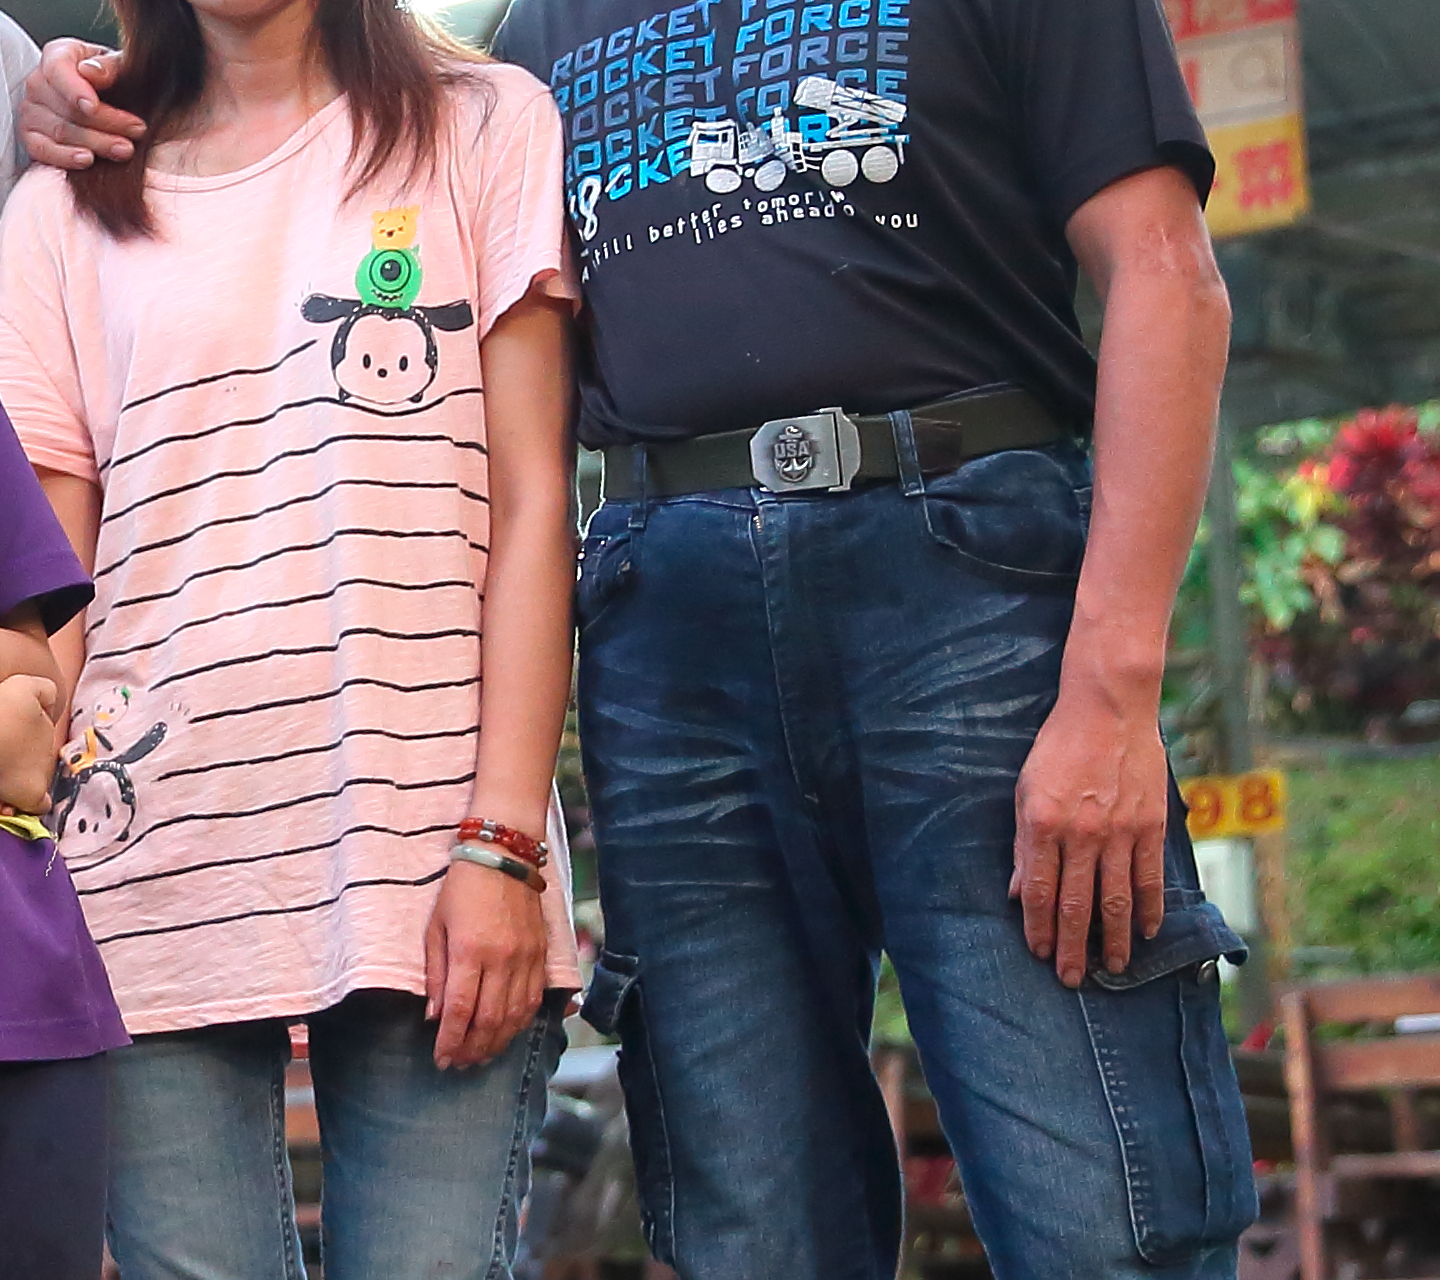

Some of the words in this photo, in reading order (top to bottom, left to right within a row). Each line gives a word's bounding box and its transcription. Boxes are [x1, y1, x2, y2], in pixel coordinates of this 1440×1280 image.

[554, 28, 717, 113] ROCKET
[570, 66, 722, 141] OCKET
[732, 31, 910, 87] FORCE
[566, 105, 728, 183] OCKET
[736, 68, 908, 124] FOCE
[592, 233, 634, 272] till
[648, 203, 722, 244] better
[693, 214, 743, 245] lies
[760, 200, 835, 226] ahead
[773, 440, 810, 458] USA
